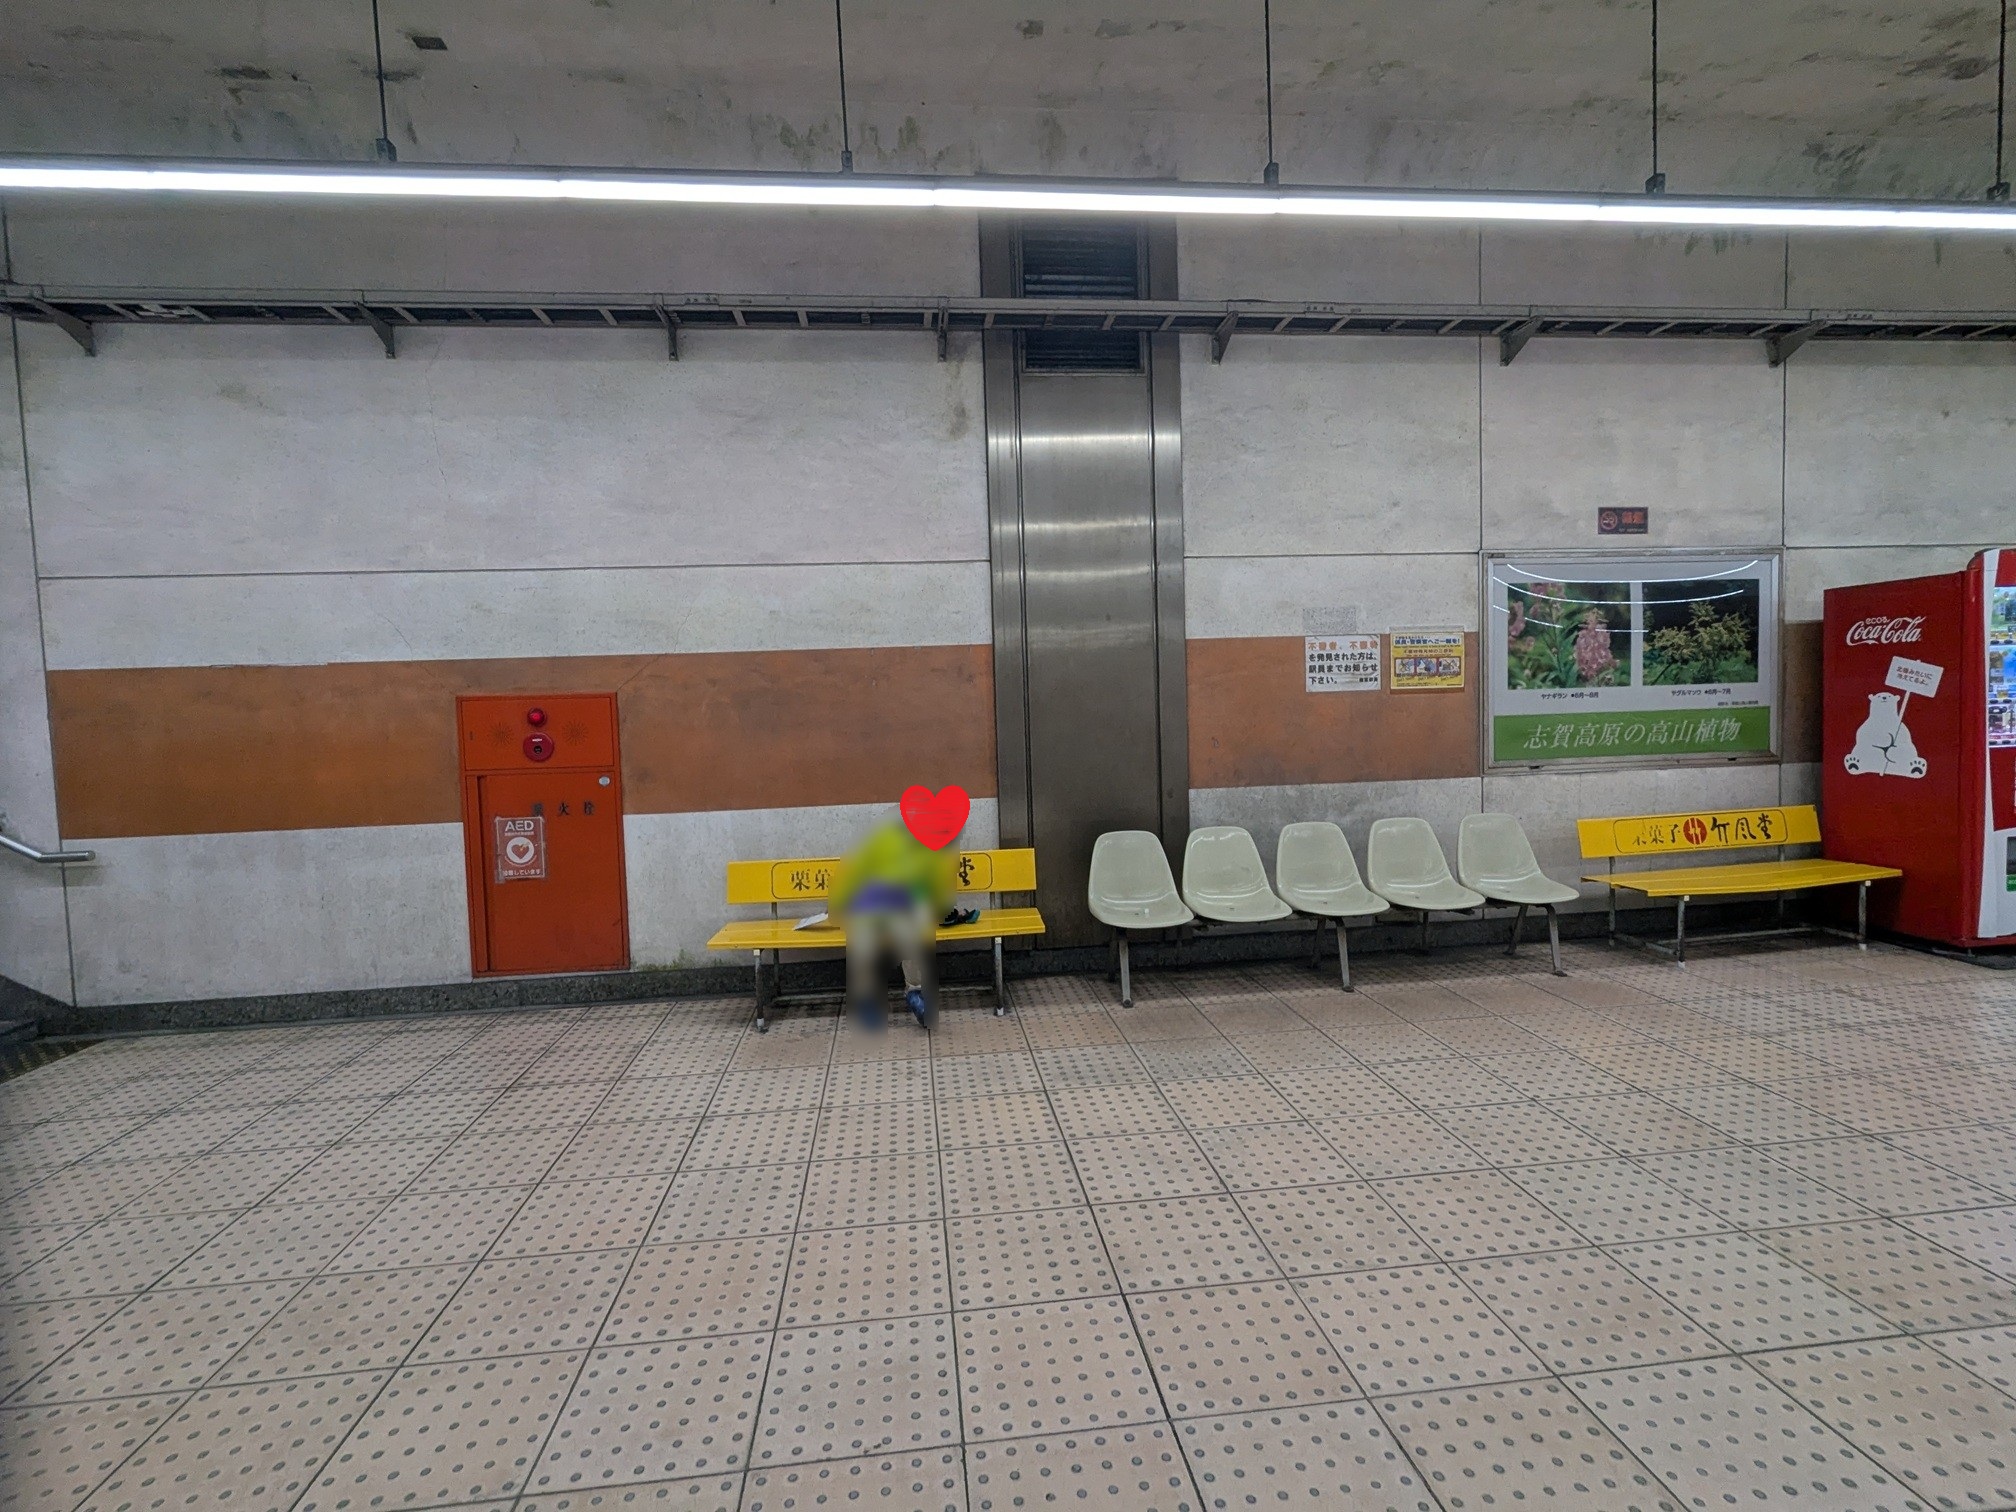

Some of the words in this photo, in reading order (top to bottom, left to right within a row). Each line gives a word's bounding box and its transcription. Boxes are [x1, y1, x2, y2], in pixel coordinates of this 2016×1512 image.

[1846, 616, 1926, 646] Coca-Cola
[1309, 652, 1377, 662] を発見された方は、
[1308, 663, 1378, 673] 駅員までお知らせ
[1309, 676, 1338, 685] 下さい。
[1523, 717, 1742, 749] 志賀高原の高山植物
[505, 820, 534, 832] AED
